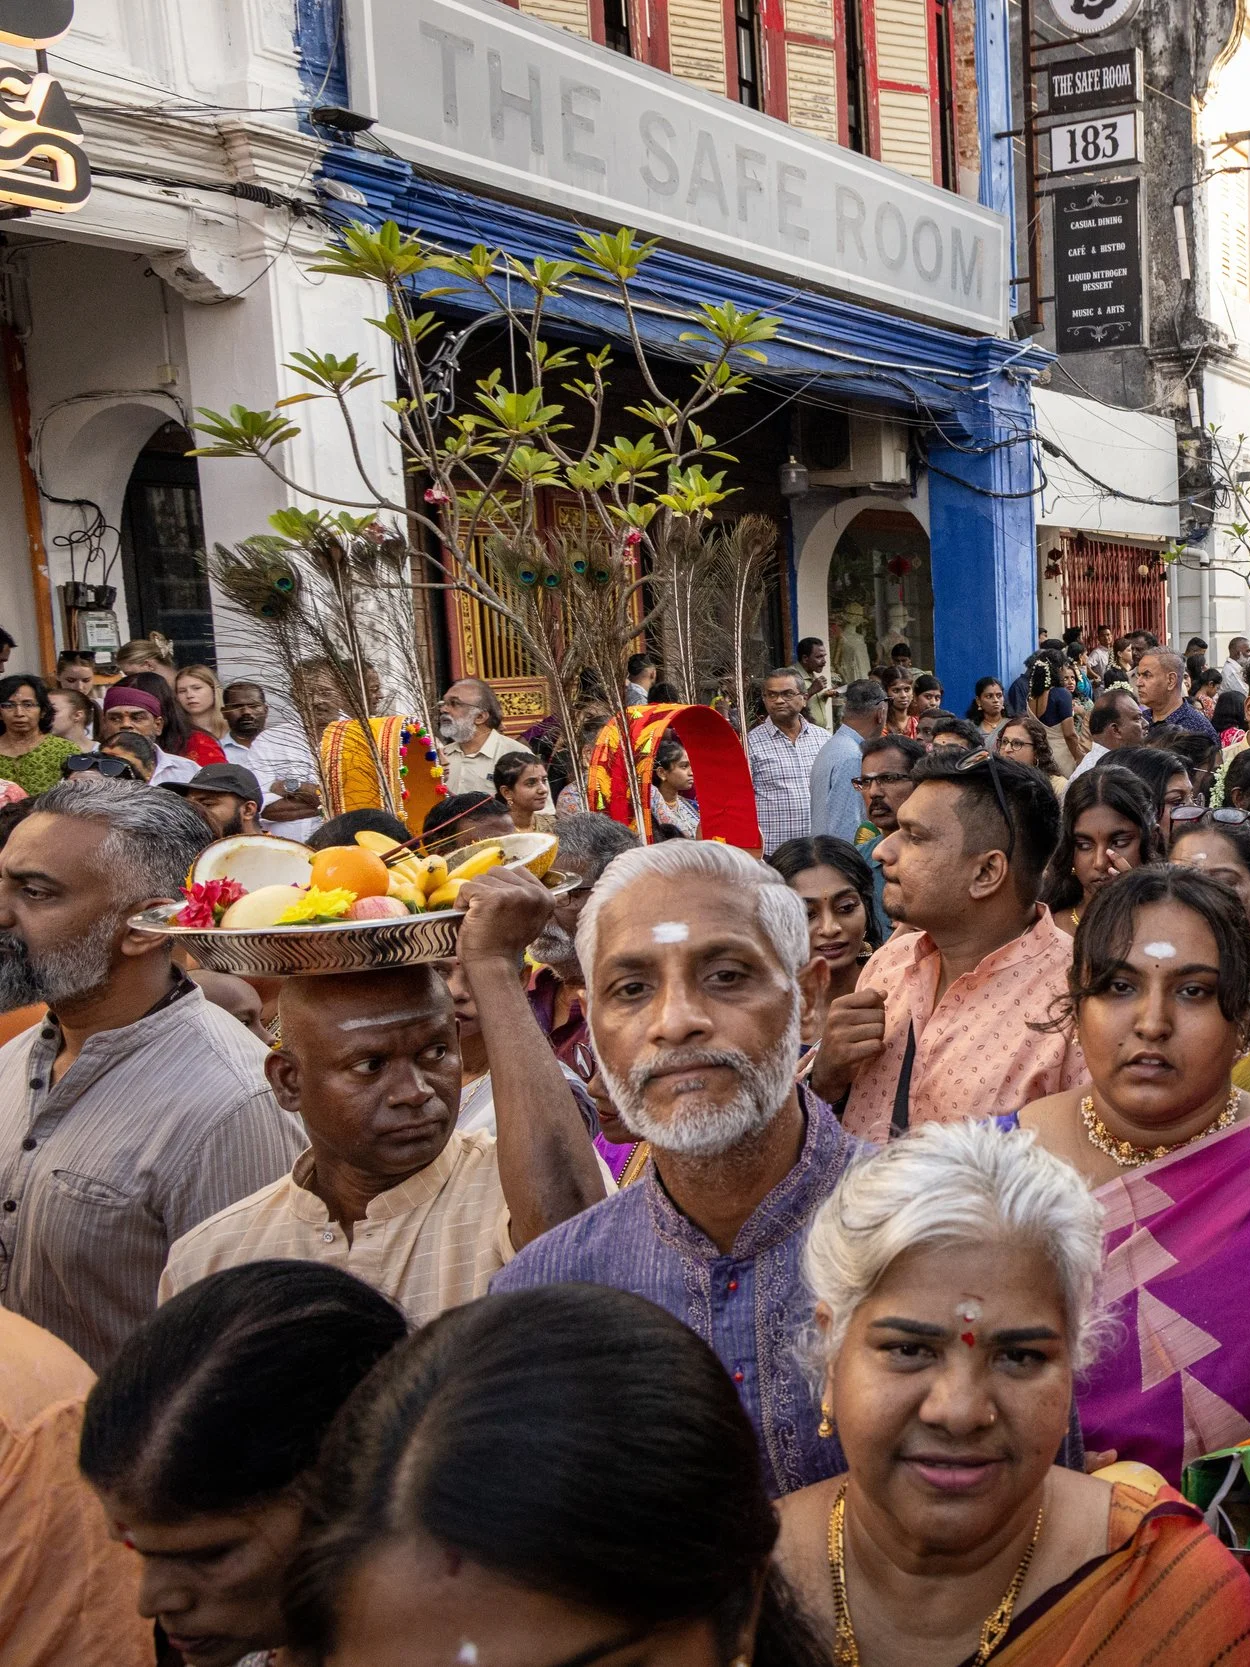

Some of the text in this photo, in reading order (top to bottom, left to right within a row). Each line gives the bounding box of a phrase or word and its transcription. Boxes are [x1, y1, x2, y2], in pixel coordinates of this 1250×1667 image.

[1052, 63, 1132, 97] THE SAFE ROOM
[1066, 121, 1120, 165] 183
[419, 19, 984, 298] THE SAFE ROOM
[1070, 215, 1123, 230] CASUAL DINING
[1068, 242, 1126, 257] CAFÉ & BISTRO
[1068, 267, 1128, 283] LIQUID NITROGEN
[1082, 281, 1113, 292] DESSERT
[1072, 304, 1125, 318] MUSIC & ARTS
